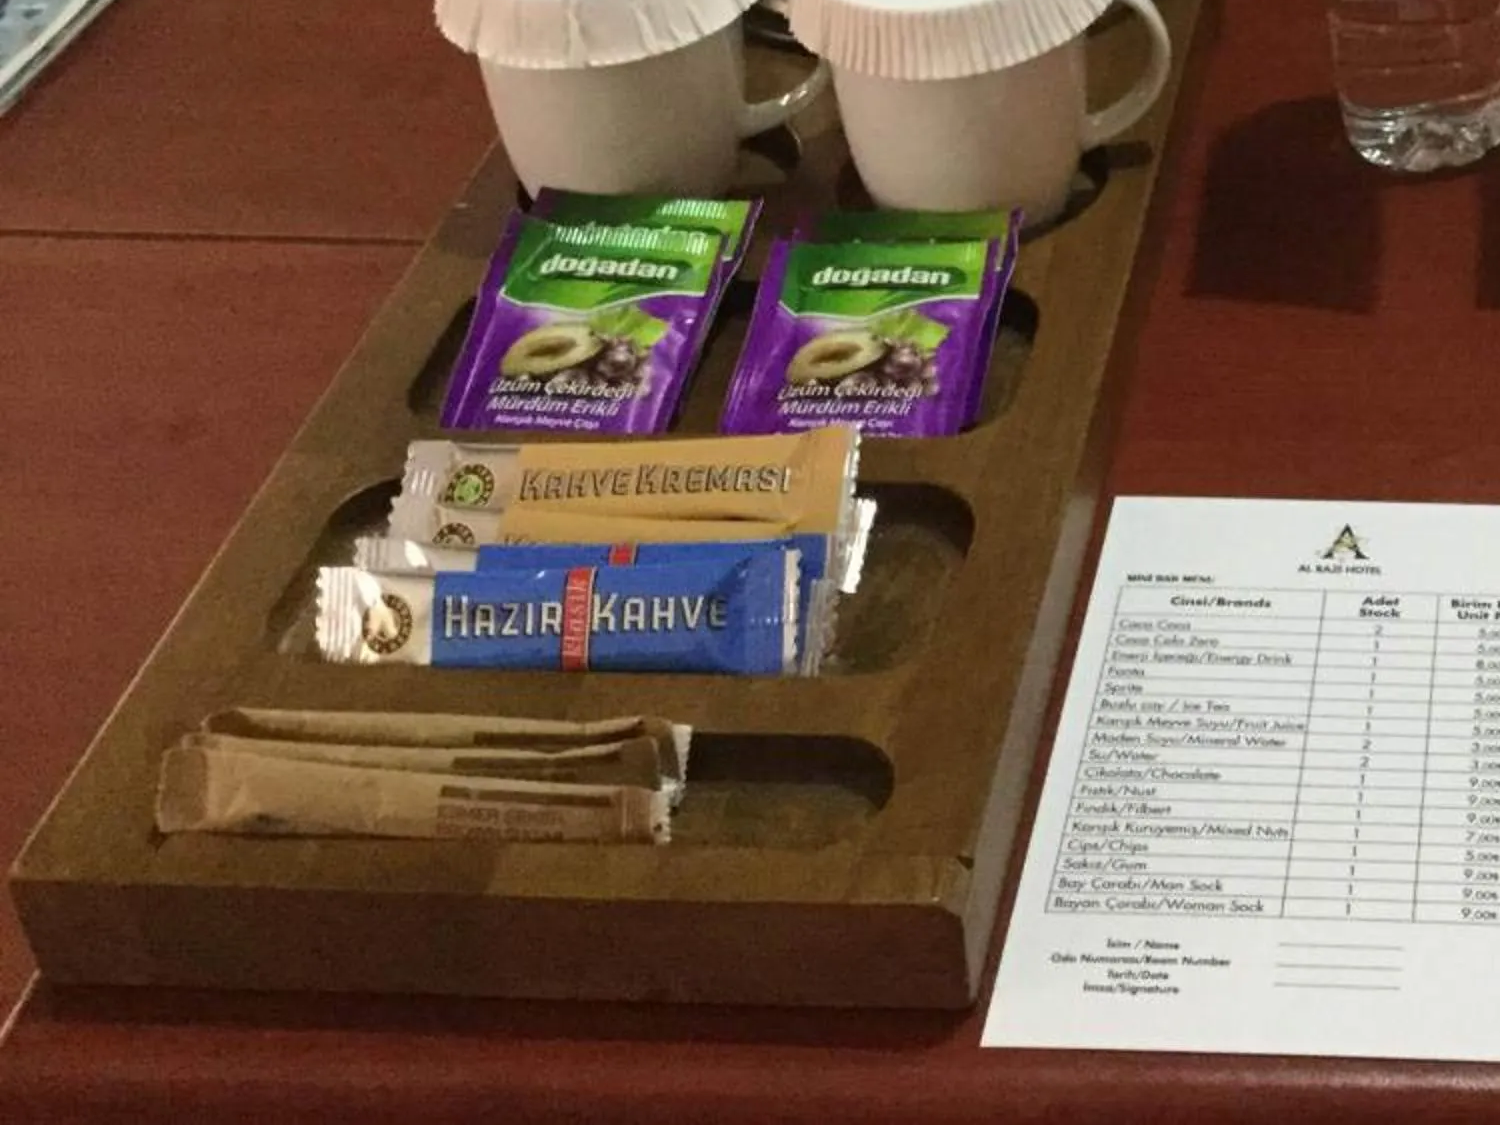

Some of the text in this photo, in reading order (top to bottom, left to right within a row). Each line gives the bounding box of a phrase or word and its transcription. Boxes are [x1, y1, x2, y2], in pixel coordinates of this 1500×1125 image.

[1362, 596, 1400, 607] Adet
[444, 594, 562, 639] HAZIR
[592, 592, 729, 633] KAHVE
[1359, 607, 1401, 619] Stock
[1457, 610, 1489, 622] Unit
[1190, 878, 1223, 893] Sock
[1229, 899, 1264, 913] Sock
[1145, 939, 1180, 951] Name
[1181, 955, 1231, 967] Number
